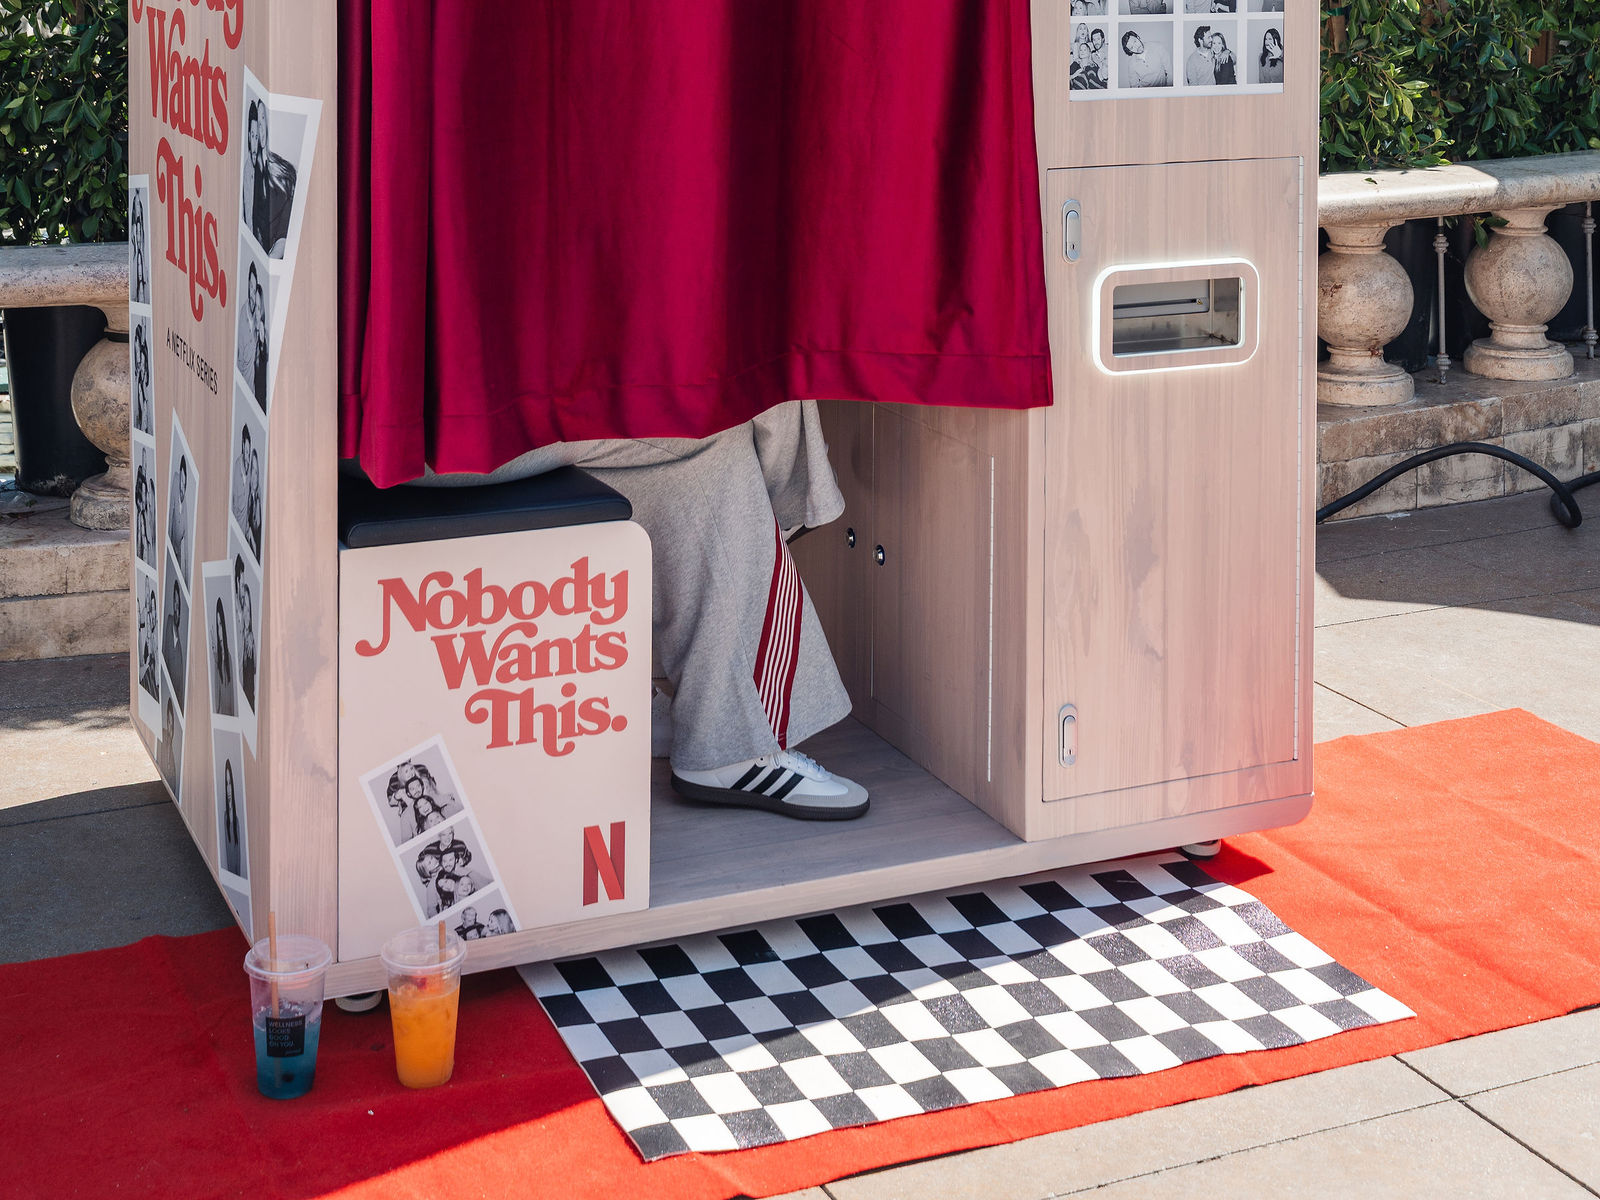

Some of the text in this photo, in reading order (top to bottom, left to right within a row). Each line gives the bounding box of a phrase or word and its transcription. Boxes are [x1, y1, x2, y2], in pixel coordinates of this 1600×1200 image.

[146, 6, 228, 156] Wants
[156, 136, 227, 322] This.
[166, 327, 218, 395] A NETFLIX SERIES
[355, 556, 628, 657] Nobody
[430, 622, 628, 690] Wants
[464, 682, 628, 757] This.
[583, 821, 626, 907] N
